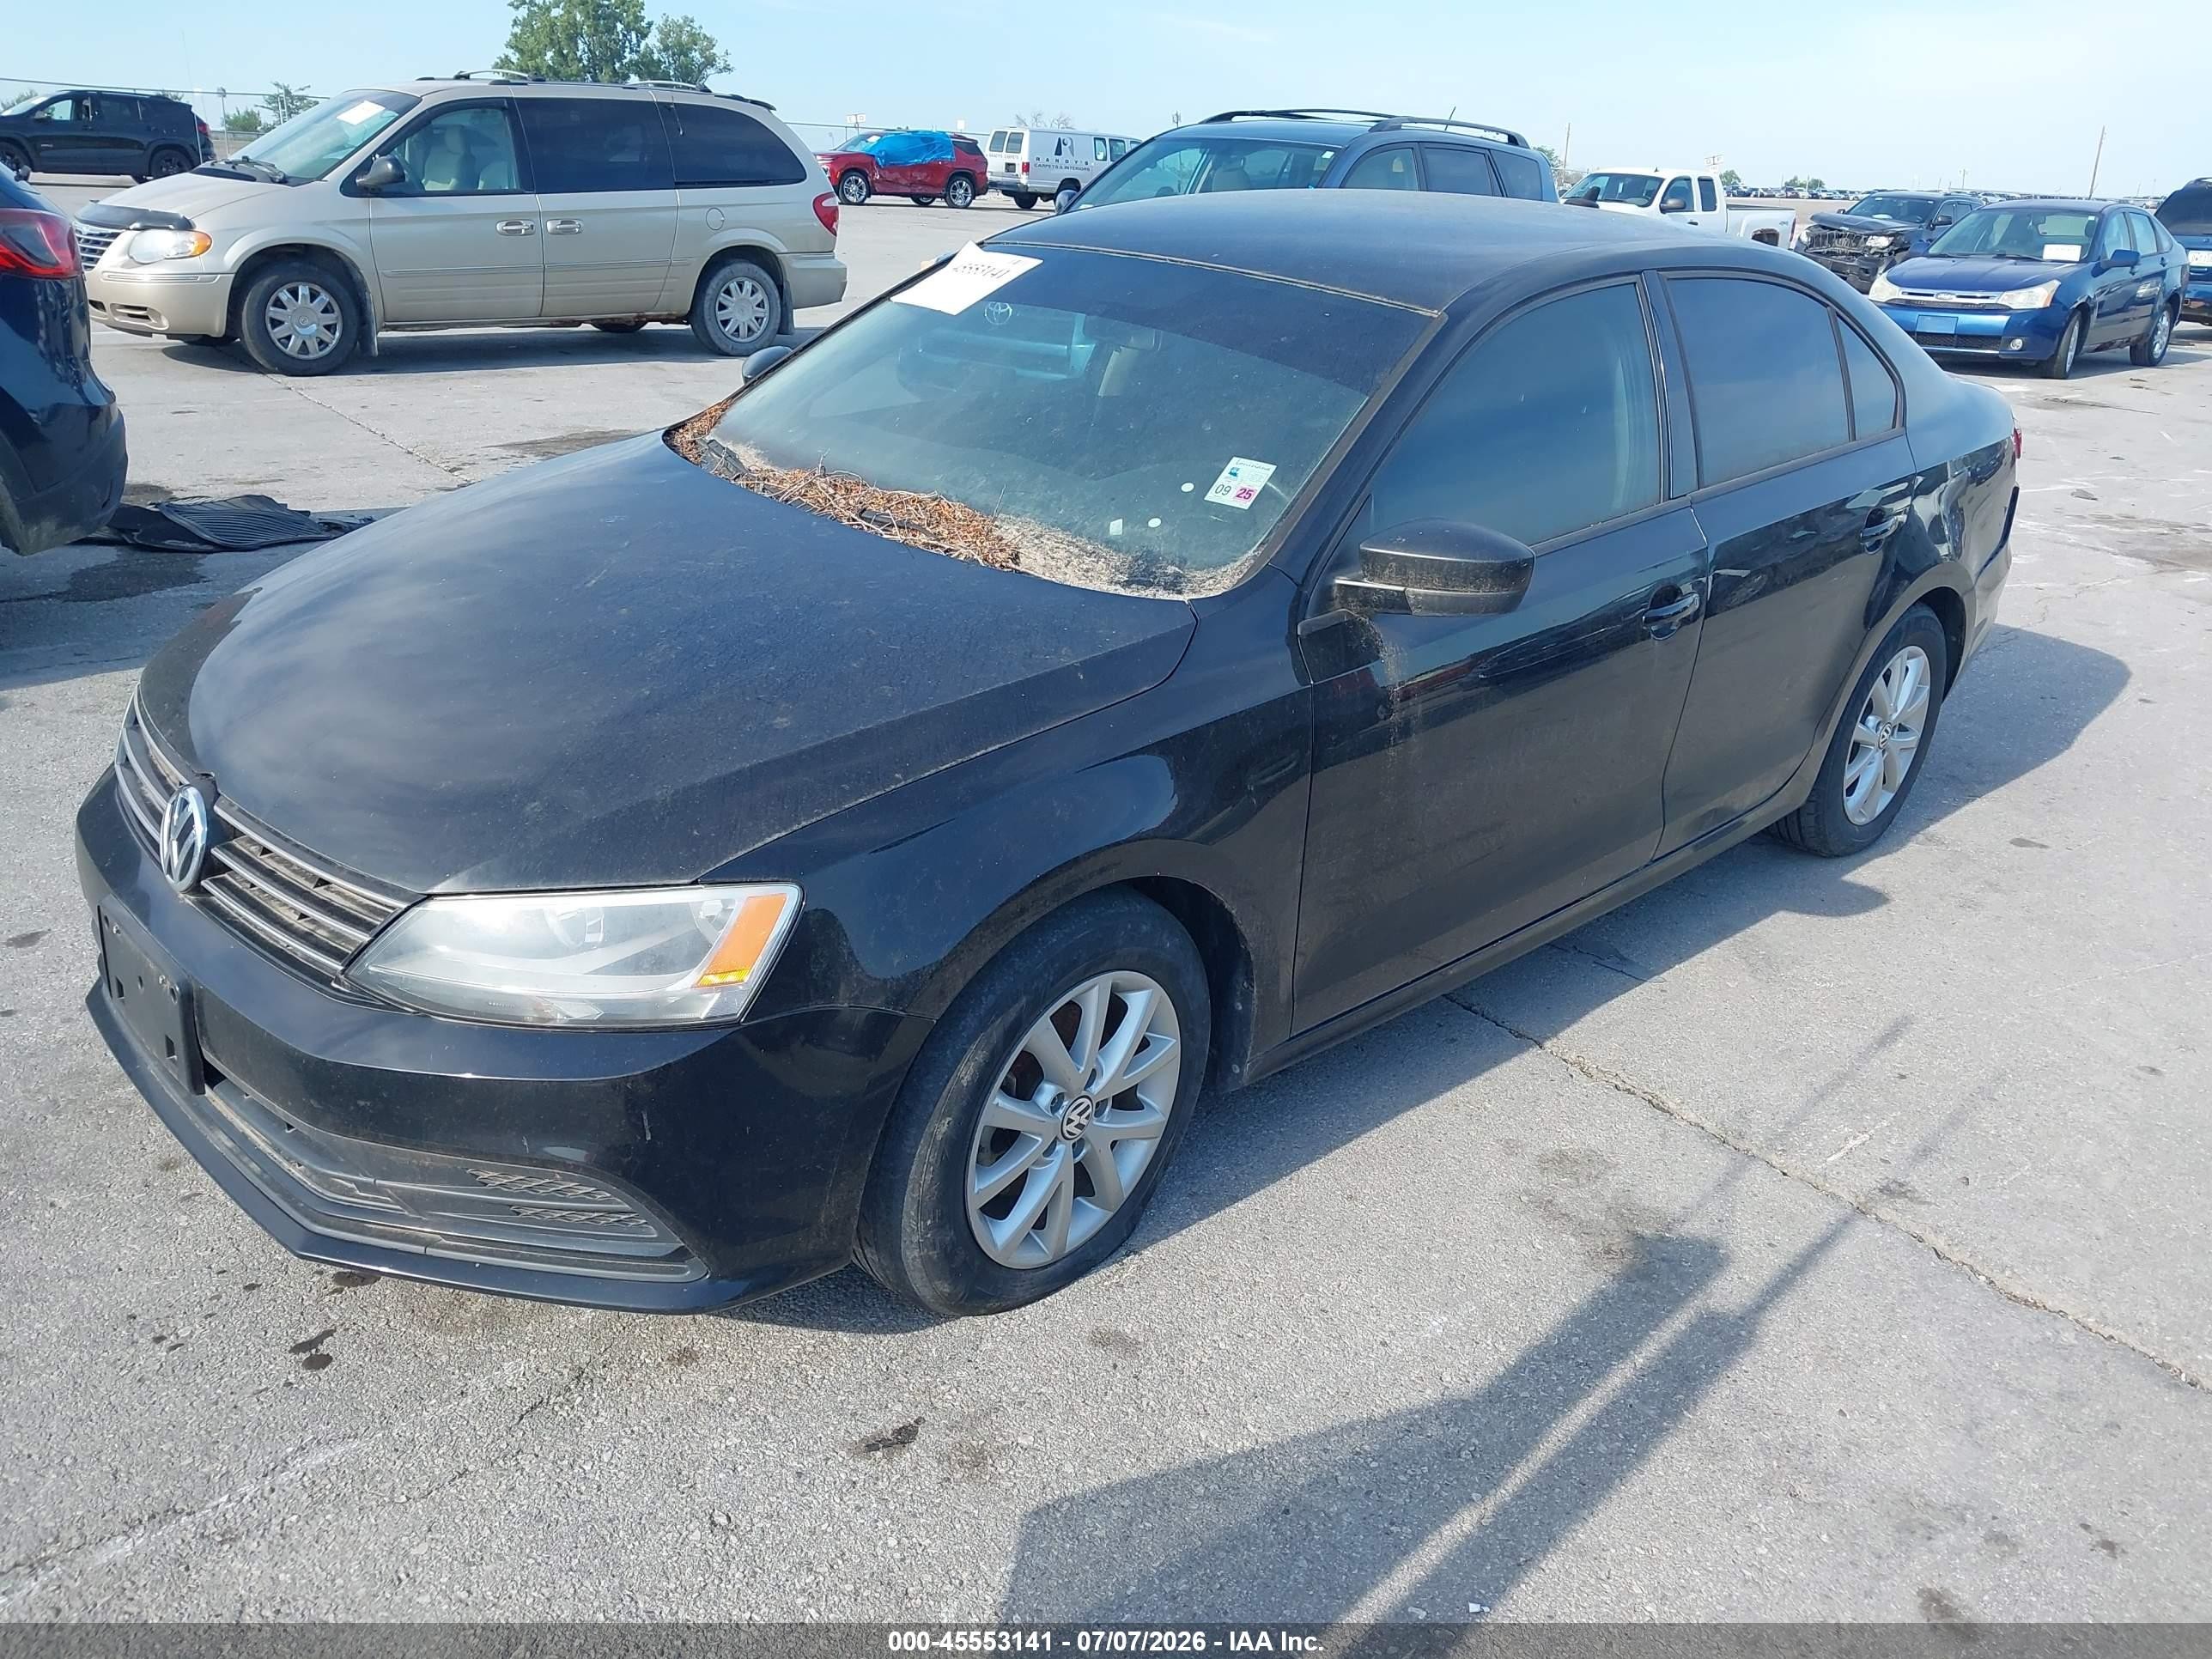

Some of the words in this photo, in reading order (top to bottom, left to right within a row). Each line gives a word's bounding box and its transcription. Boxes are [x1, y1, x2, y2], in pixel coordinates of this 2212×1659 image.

[1036, 156, 1089, 166] RANDY'S
[1214, 483, 1232, 495] 09
[1236, 488, 1255, 500] 25
